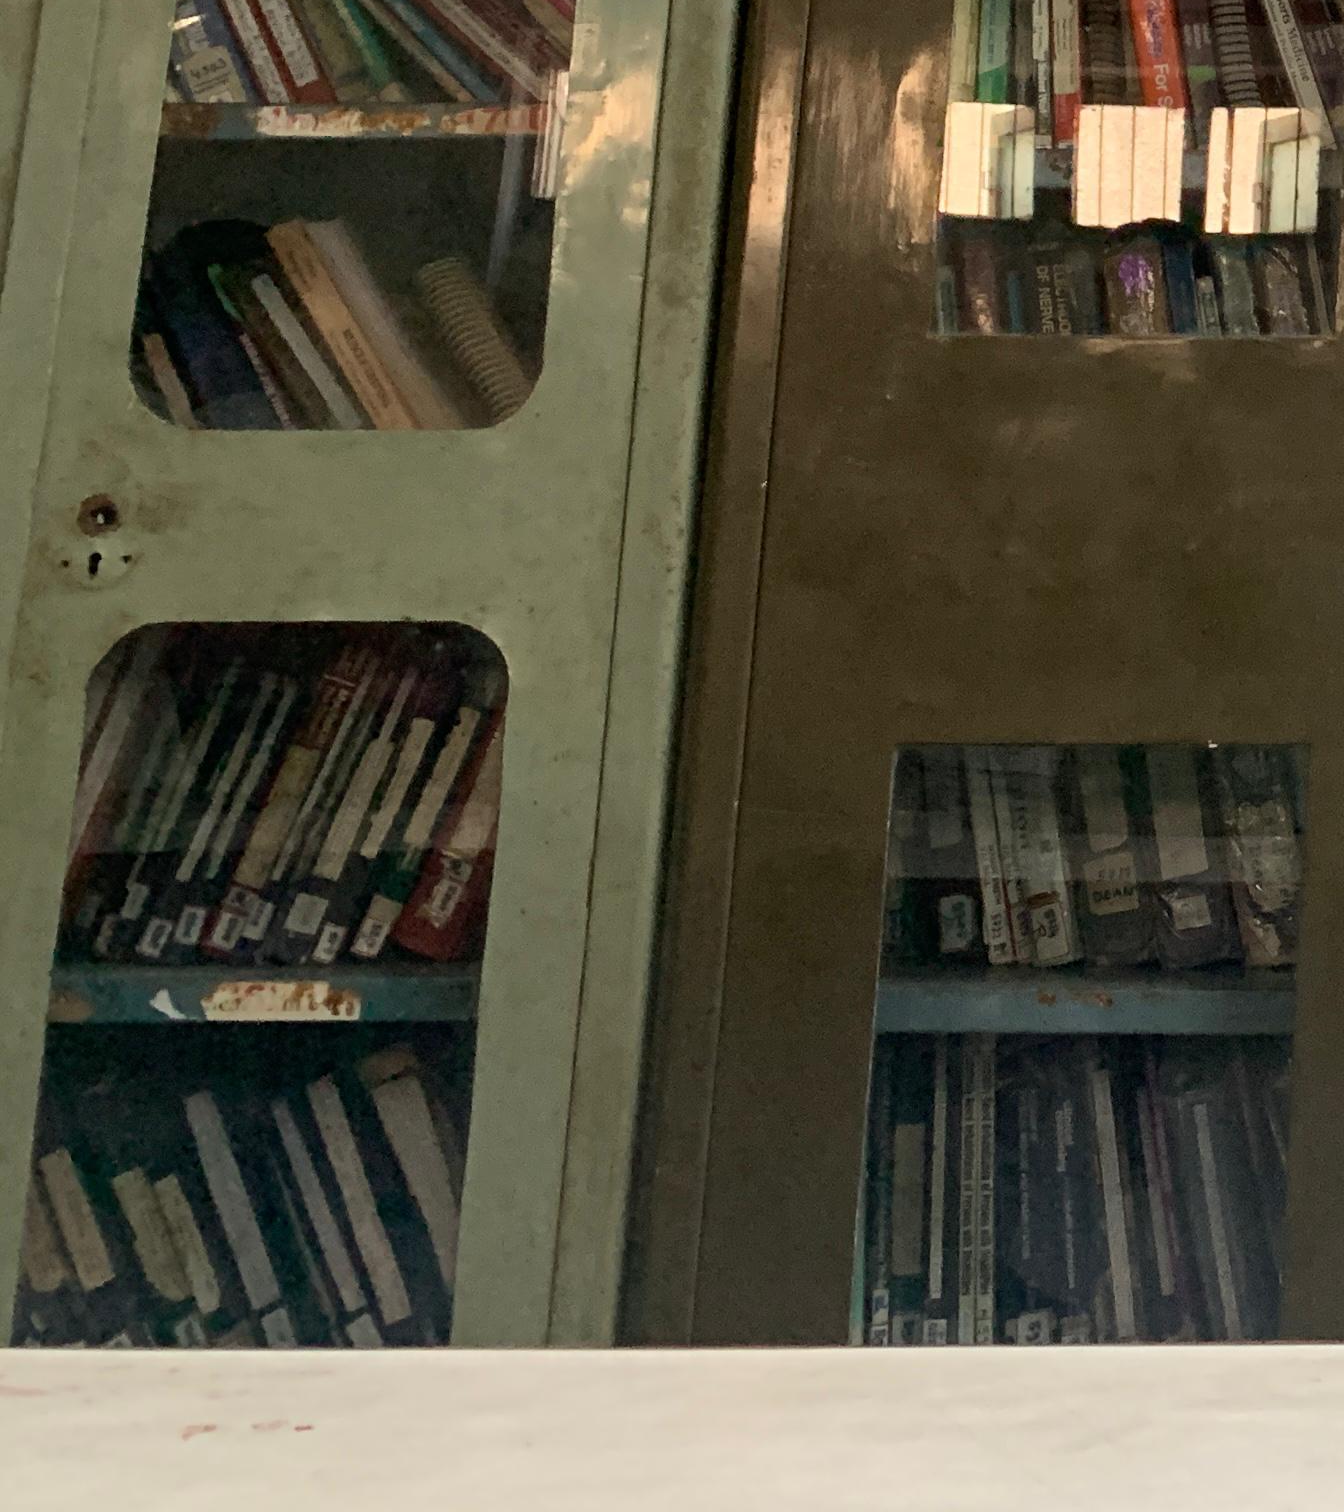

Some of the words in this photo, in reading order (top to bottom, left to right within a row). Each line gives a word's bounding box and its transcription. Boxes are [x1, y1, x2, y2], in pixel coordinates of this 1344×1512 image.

[1286, 26, 1311, 82] Medicine
[1153, 63, 1169, 92] For
[1035, 265, 1050, 283] OF
[1038, 287, 1055, 334] NERVE
